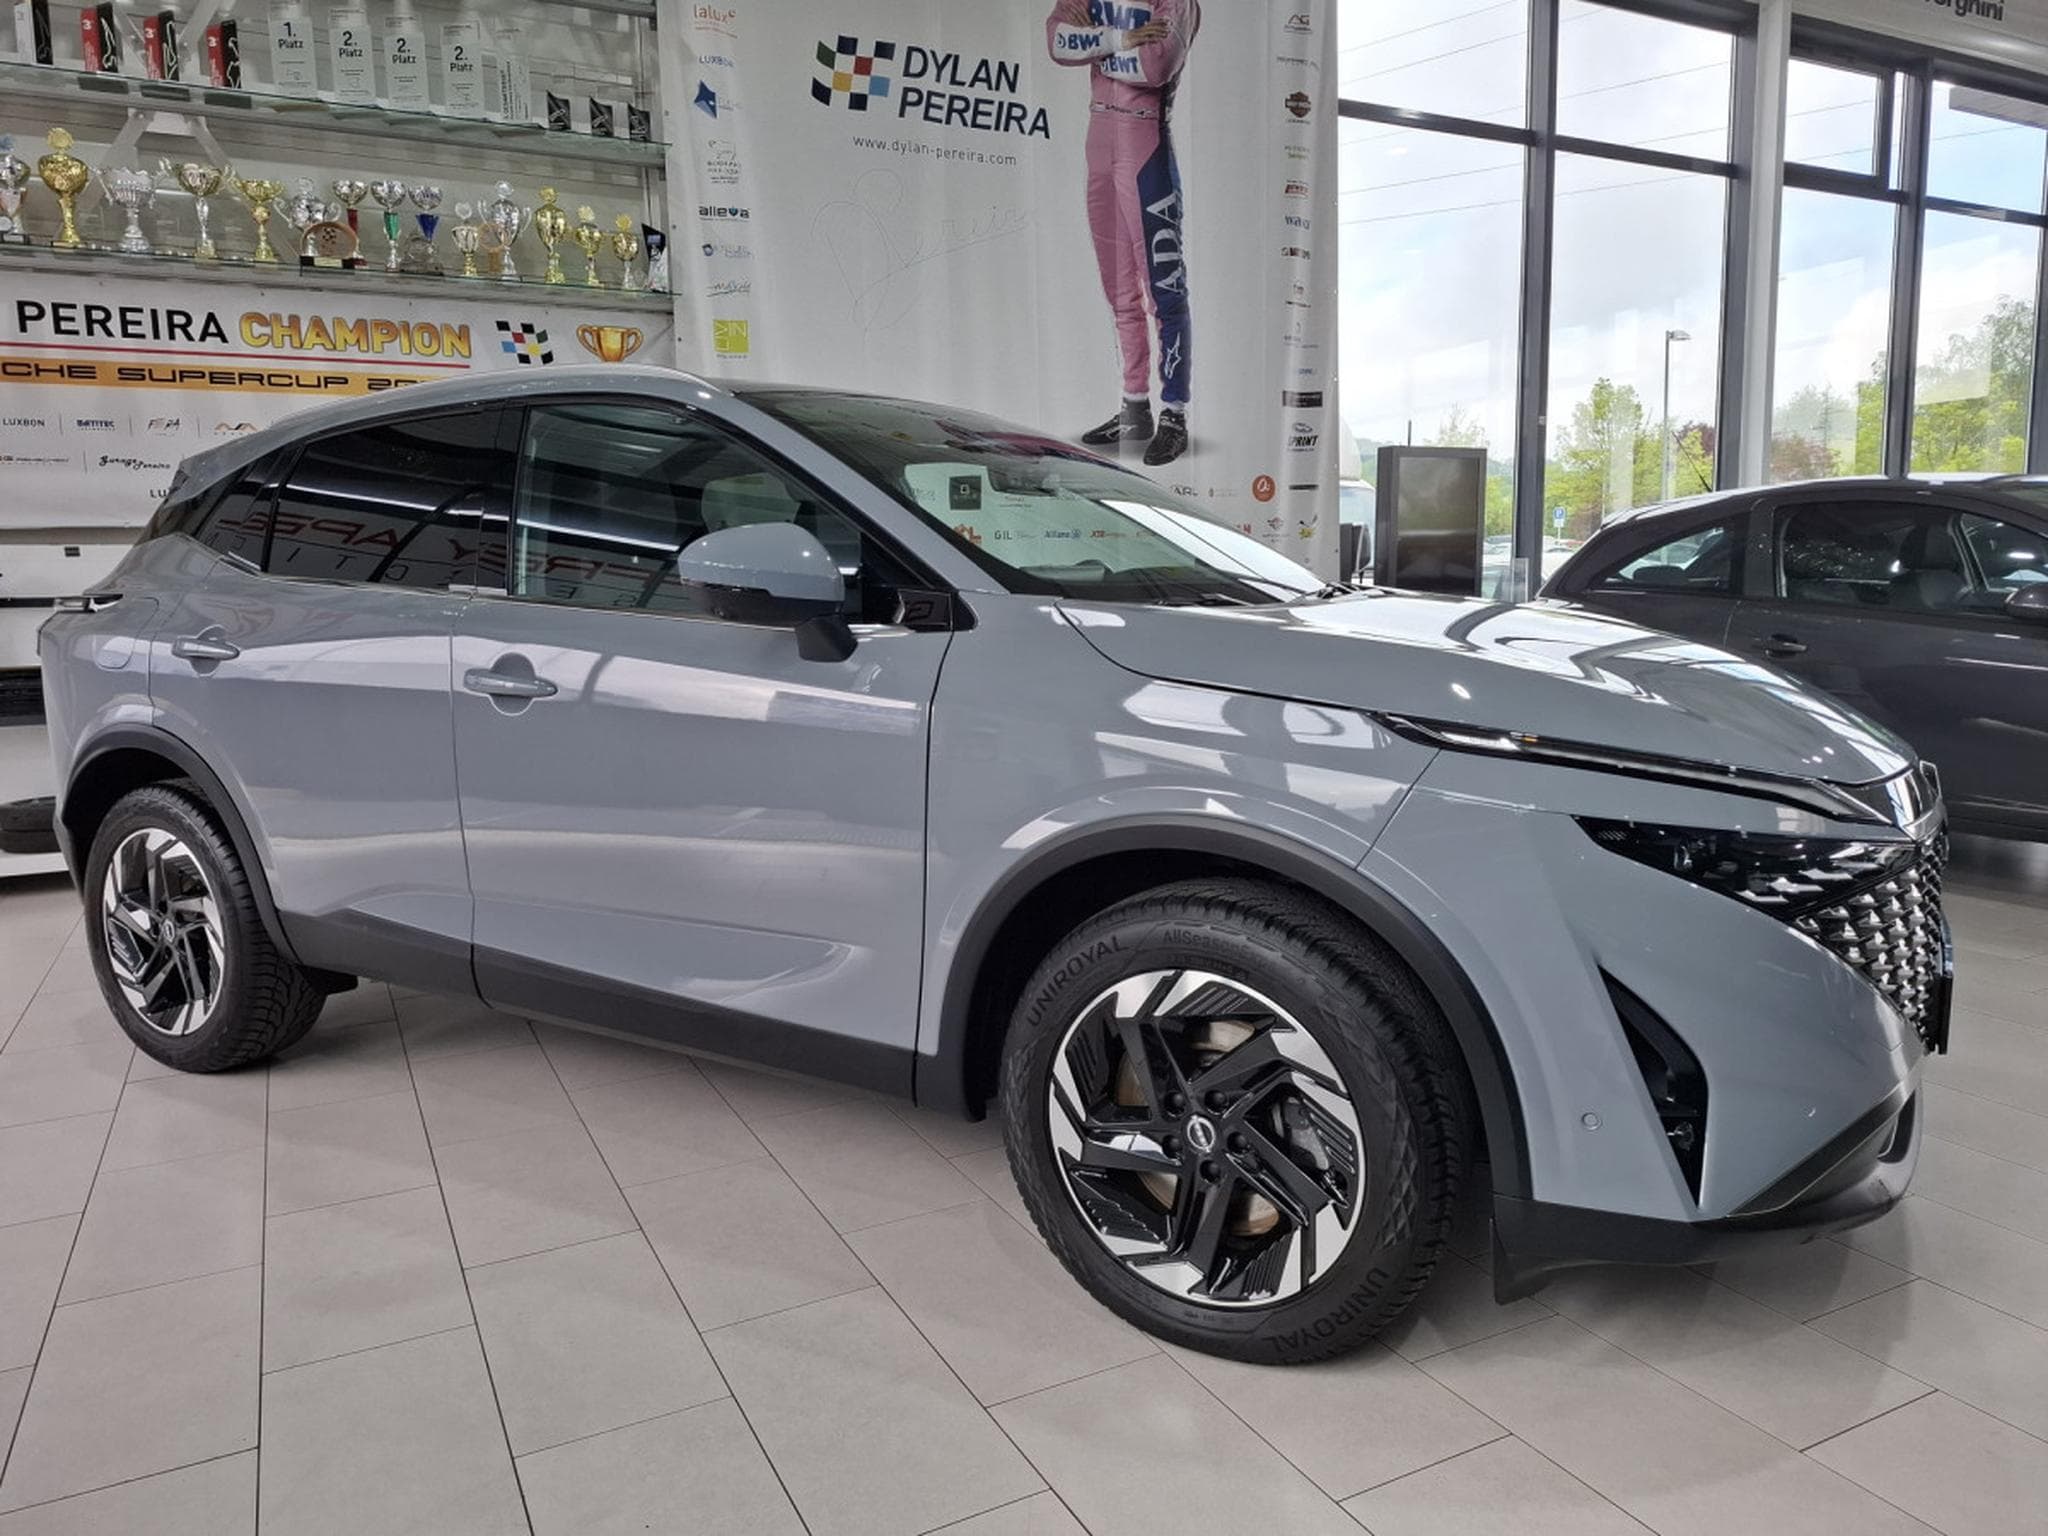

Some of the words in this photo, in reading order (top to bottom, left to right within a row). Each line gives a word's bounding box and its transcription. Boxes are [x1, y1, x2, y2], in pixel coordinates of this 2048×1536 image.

[283, 22, 297, 37] 1.
[278, 38, 304, 49] Platz
[342, 30, 357, 47] 2.
[396, 37, 411, 53] 2.
[339, 47, 363, 58] Platz
[392, 53, 416, 65] Platz
[454, 45, 468, 61] 2.
[449, 62, 473, 73] Platz
[902, 45, 1020, 94] DYLAN
[1110, 56, 1138, 73] BWT
[898, 87, 1051, 140] PEREIRA
[853, 135, 1017, 167] www.dylan-pereira.com
[16, 299, 229, 344] PEREIRA
[239, 311, 472, 359] CHAMPION
[117, 367, 349, 389] SUPERCUP
[2, 417, 45, 427] LUXBON
[150, 489, 169, 498] LU
[994, 529, 1013, 540] GIL
[1027, 935, 1131, 1026] UNIROYAL
[1262, 1268, 1389, 1352] UNIROYAL
